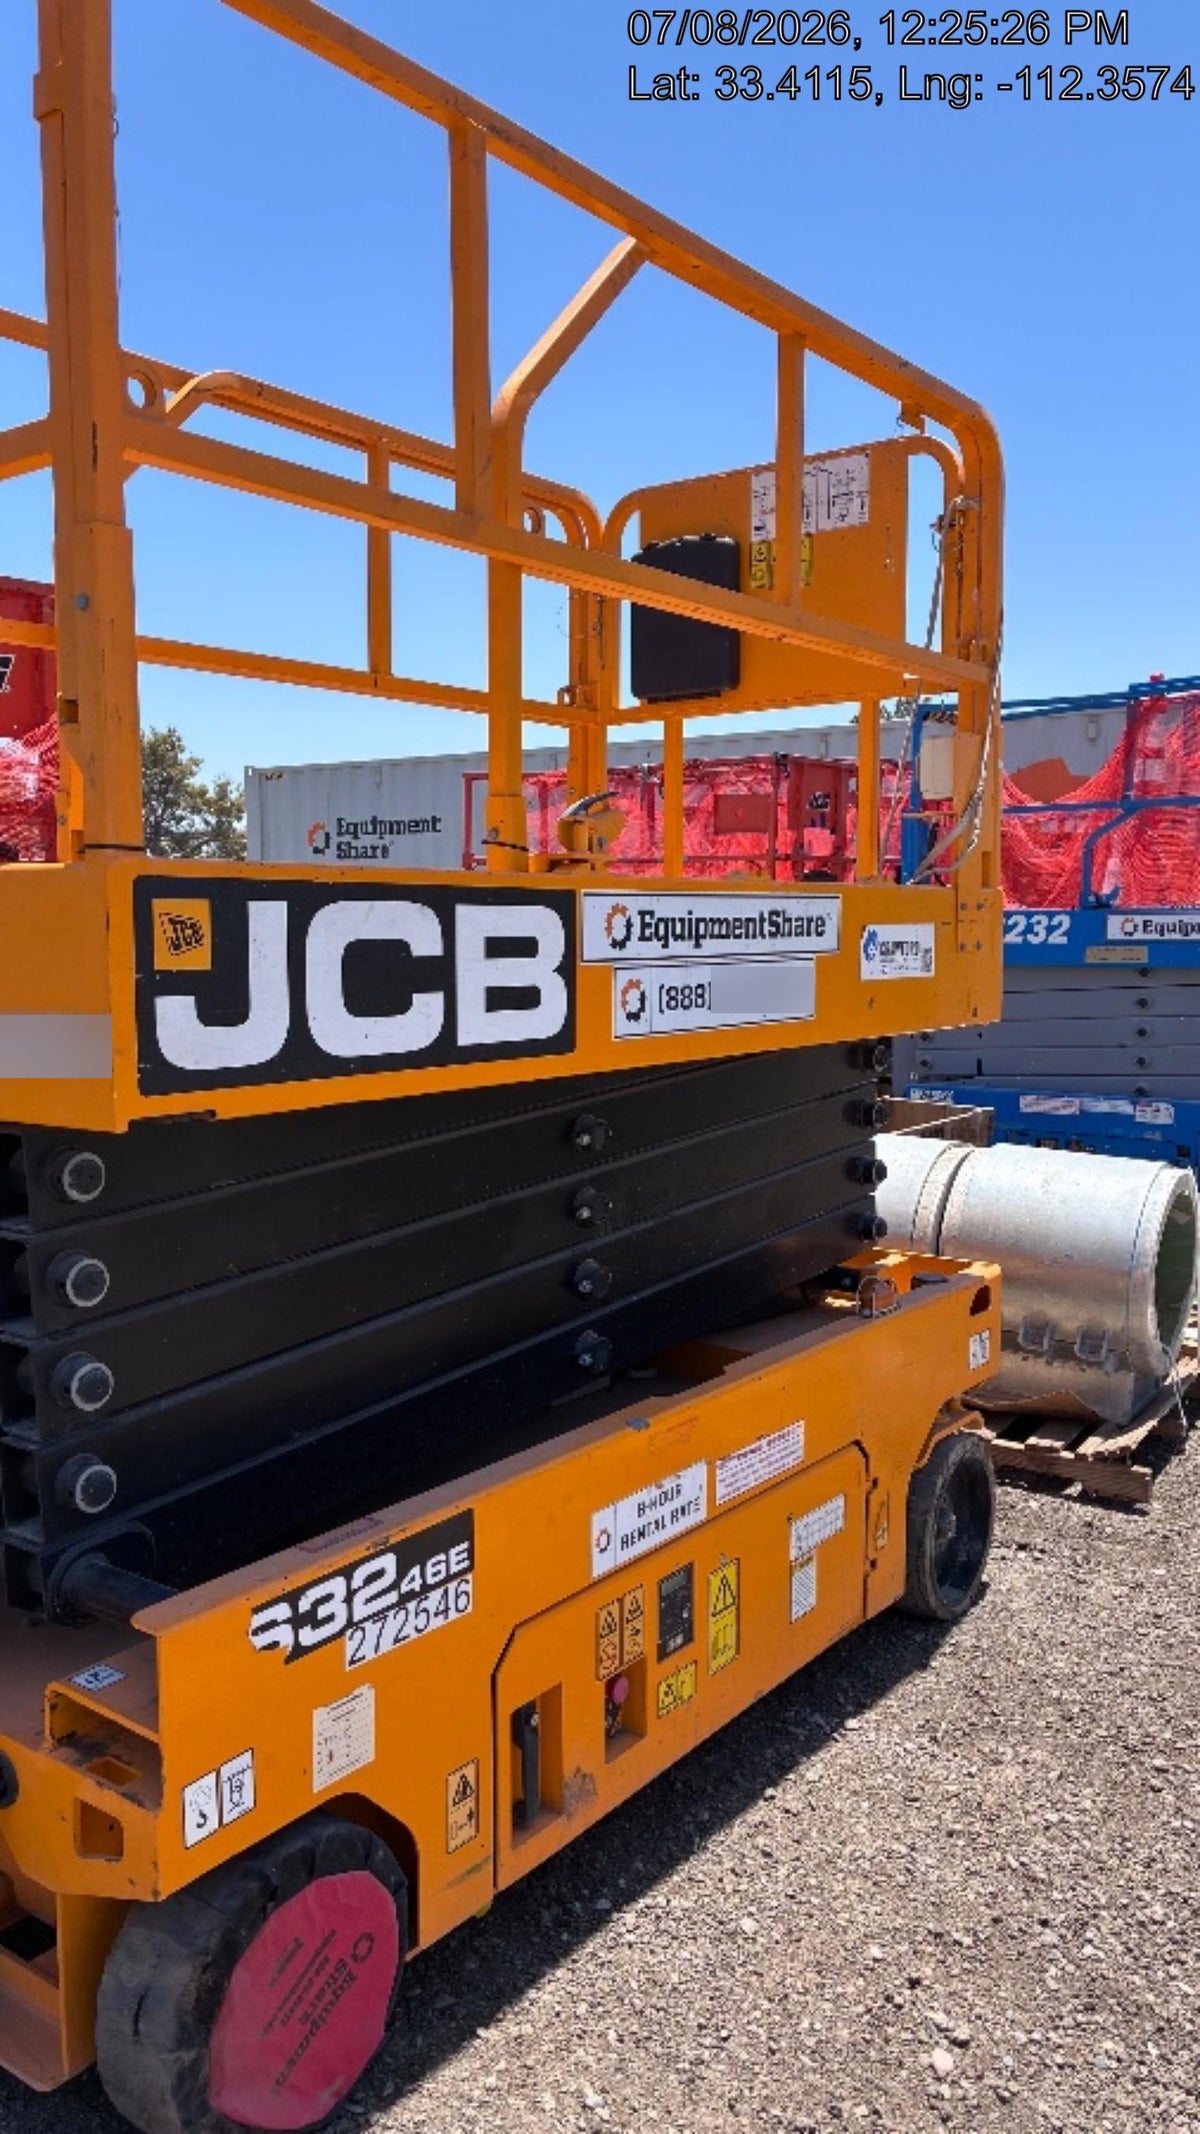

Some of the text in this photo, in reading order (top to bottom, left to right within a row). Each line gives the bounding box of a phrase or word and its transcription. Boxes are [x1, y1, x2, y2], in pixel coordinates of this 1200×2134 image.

[336, 815, 442, 839] Equipment
[336, 841, 390, 859] Share
[637, 909, 827, 949] EquipmentShare
[154, 900, 568, 1070] JCB
[620, 1495, 701, 1551] RENTAL RATE
[348, 1578, 471, 1668] 272546
